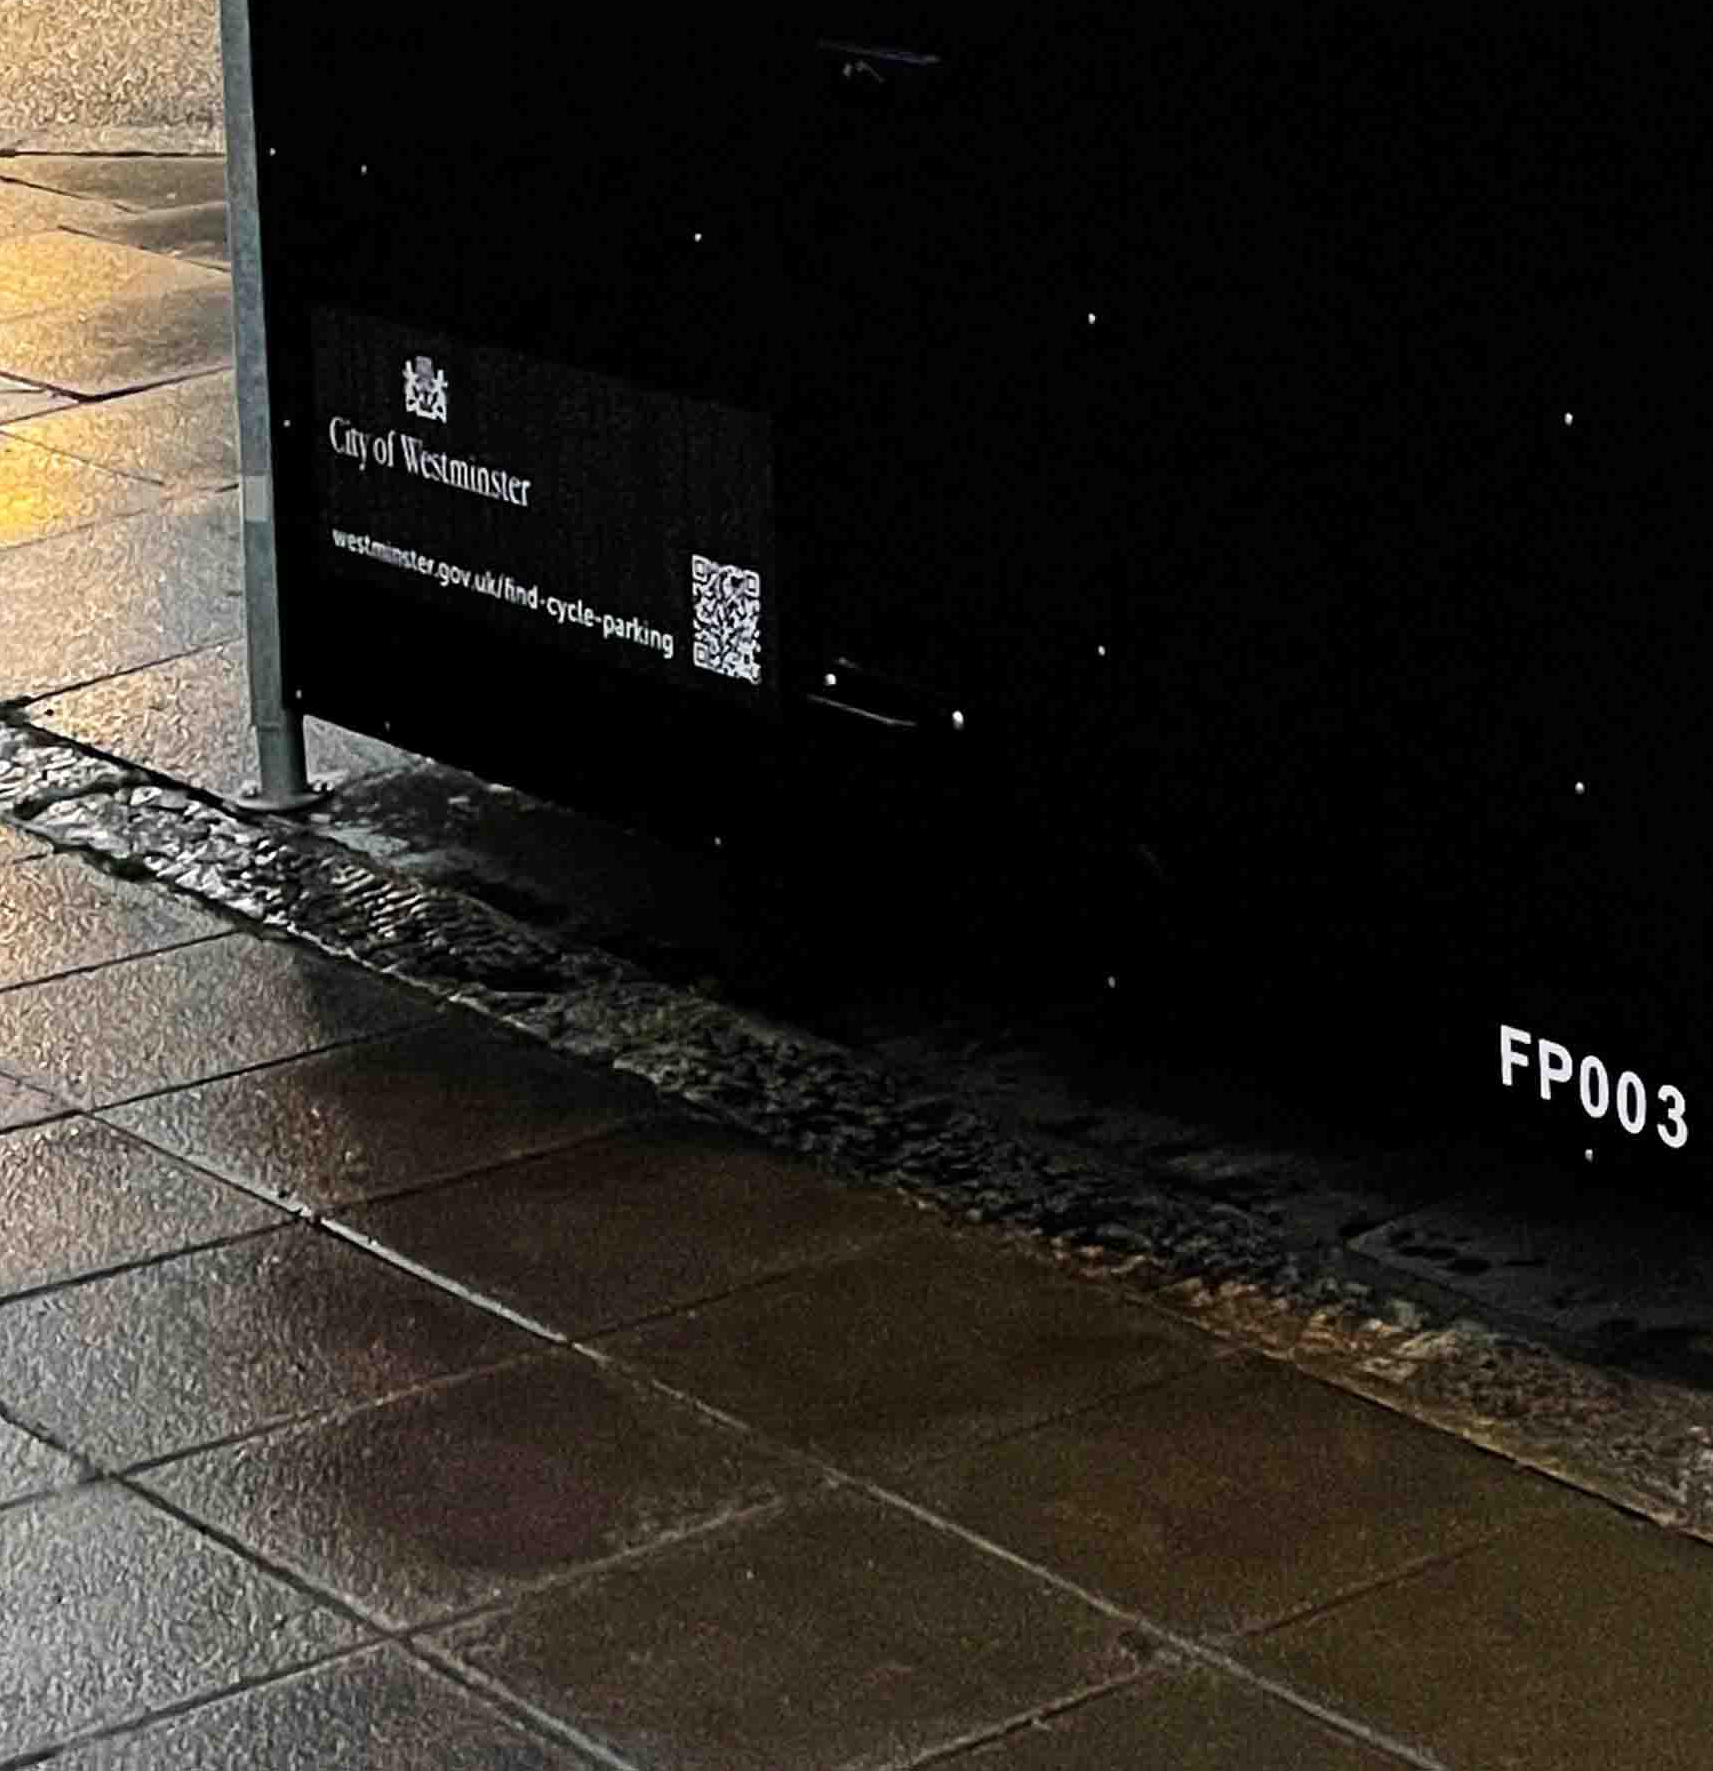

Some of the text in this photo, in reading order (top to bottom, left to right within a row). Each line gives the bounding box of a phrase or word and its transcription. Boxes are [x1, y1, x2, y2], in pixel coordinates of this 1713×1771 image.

[329, 416, 532, 507] City of Westminster
[331, 527, 674, 659] westminster.gov.uk/find-cycle-parking
[1500, 1023, 1689, 1149] FP003
